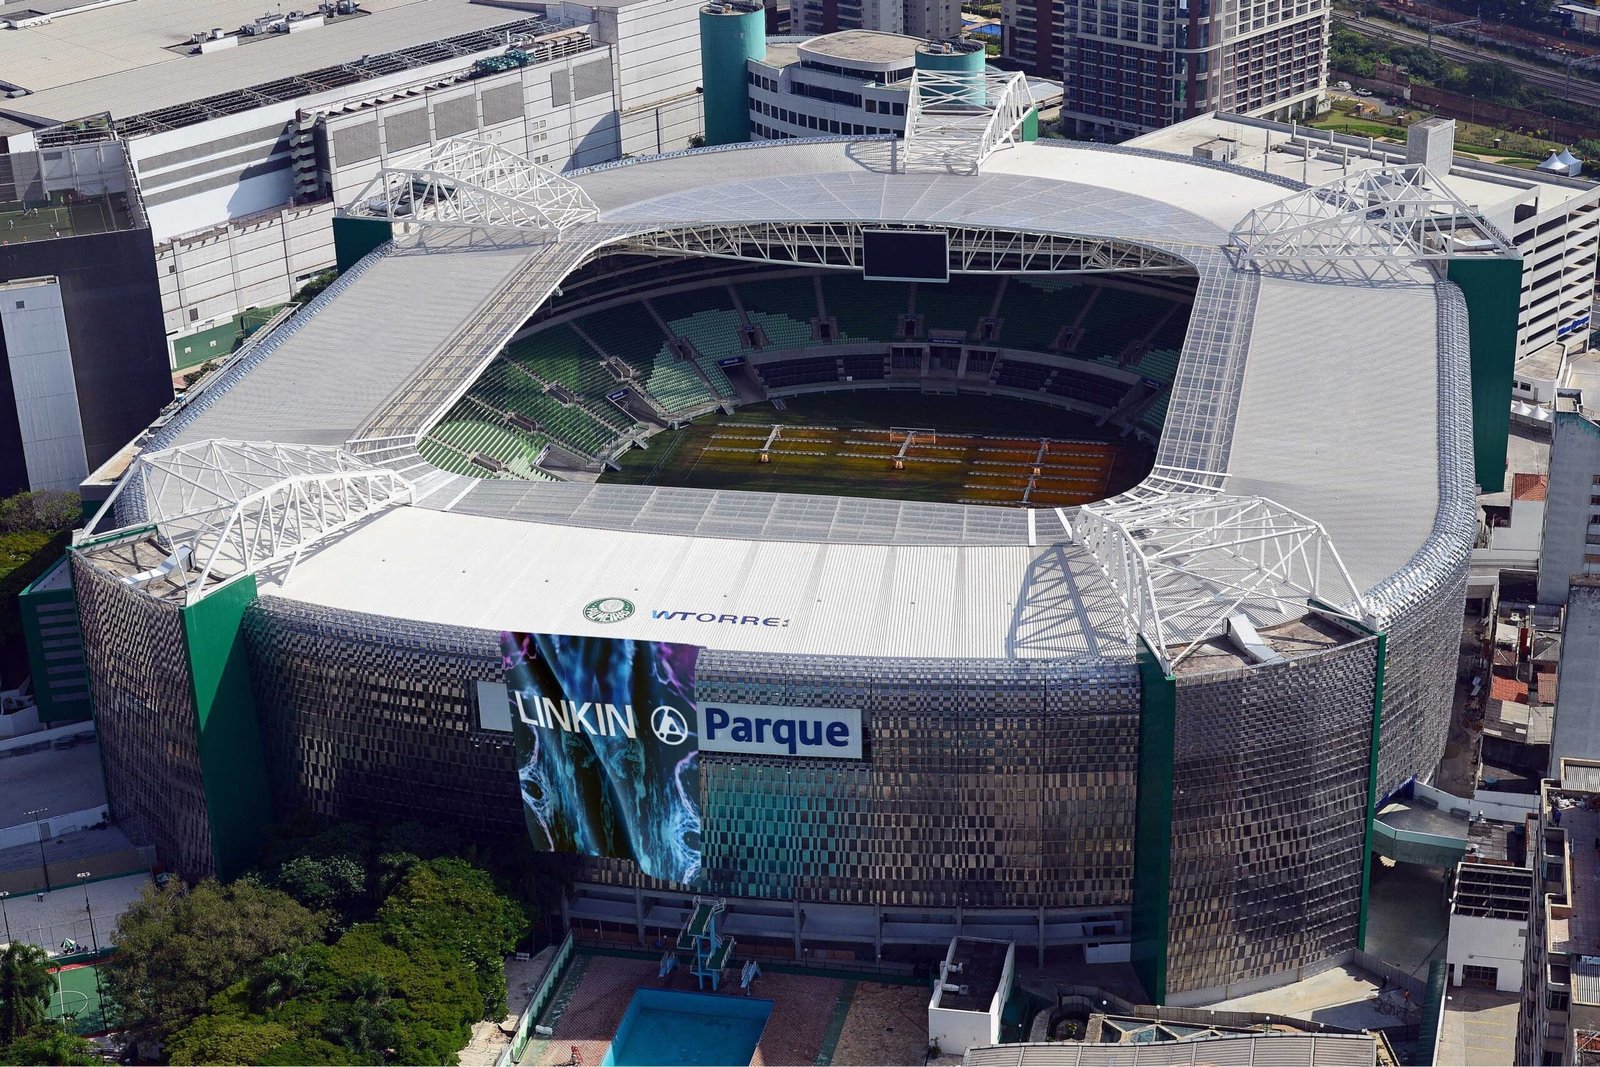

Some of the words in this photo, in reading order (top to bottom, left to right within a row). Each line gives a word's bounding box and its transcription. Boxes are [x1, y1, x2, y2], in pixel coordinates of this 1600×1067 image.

[652, 610, 780, 627] WTORRE
[514, 690, 637, 739] LINKIN
[705, 707, 850, 755] Parque
